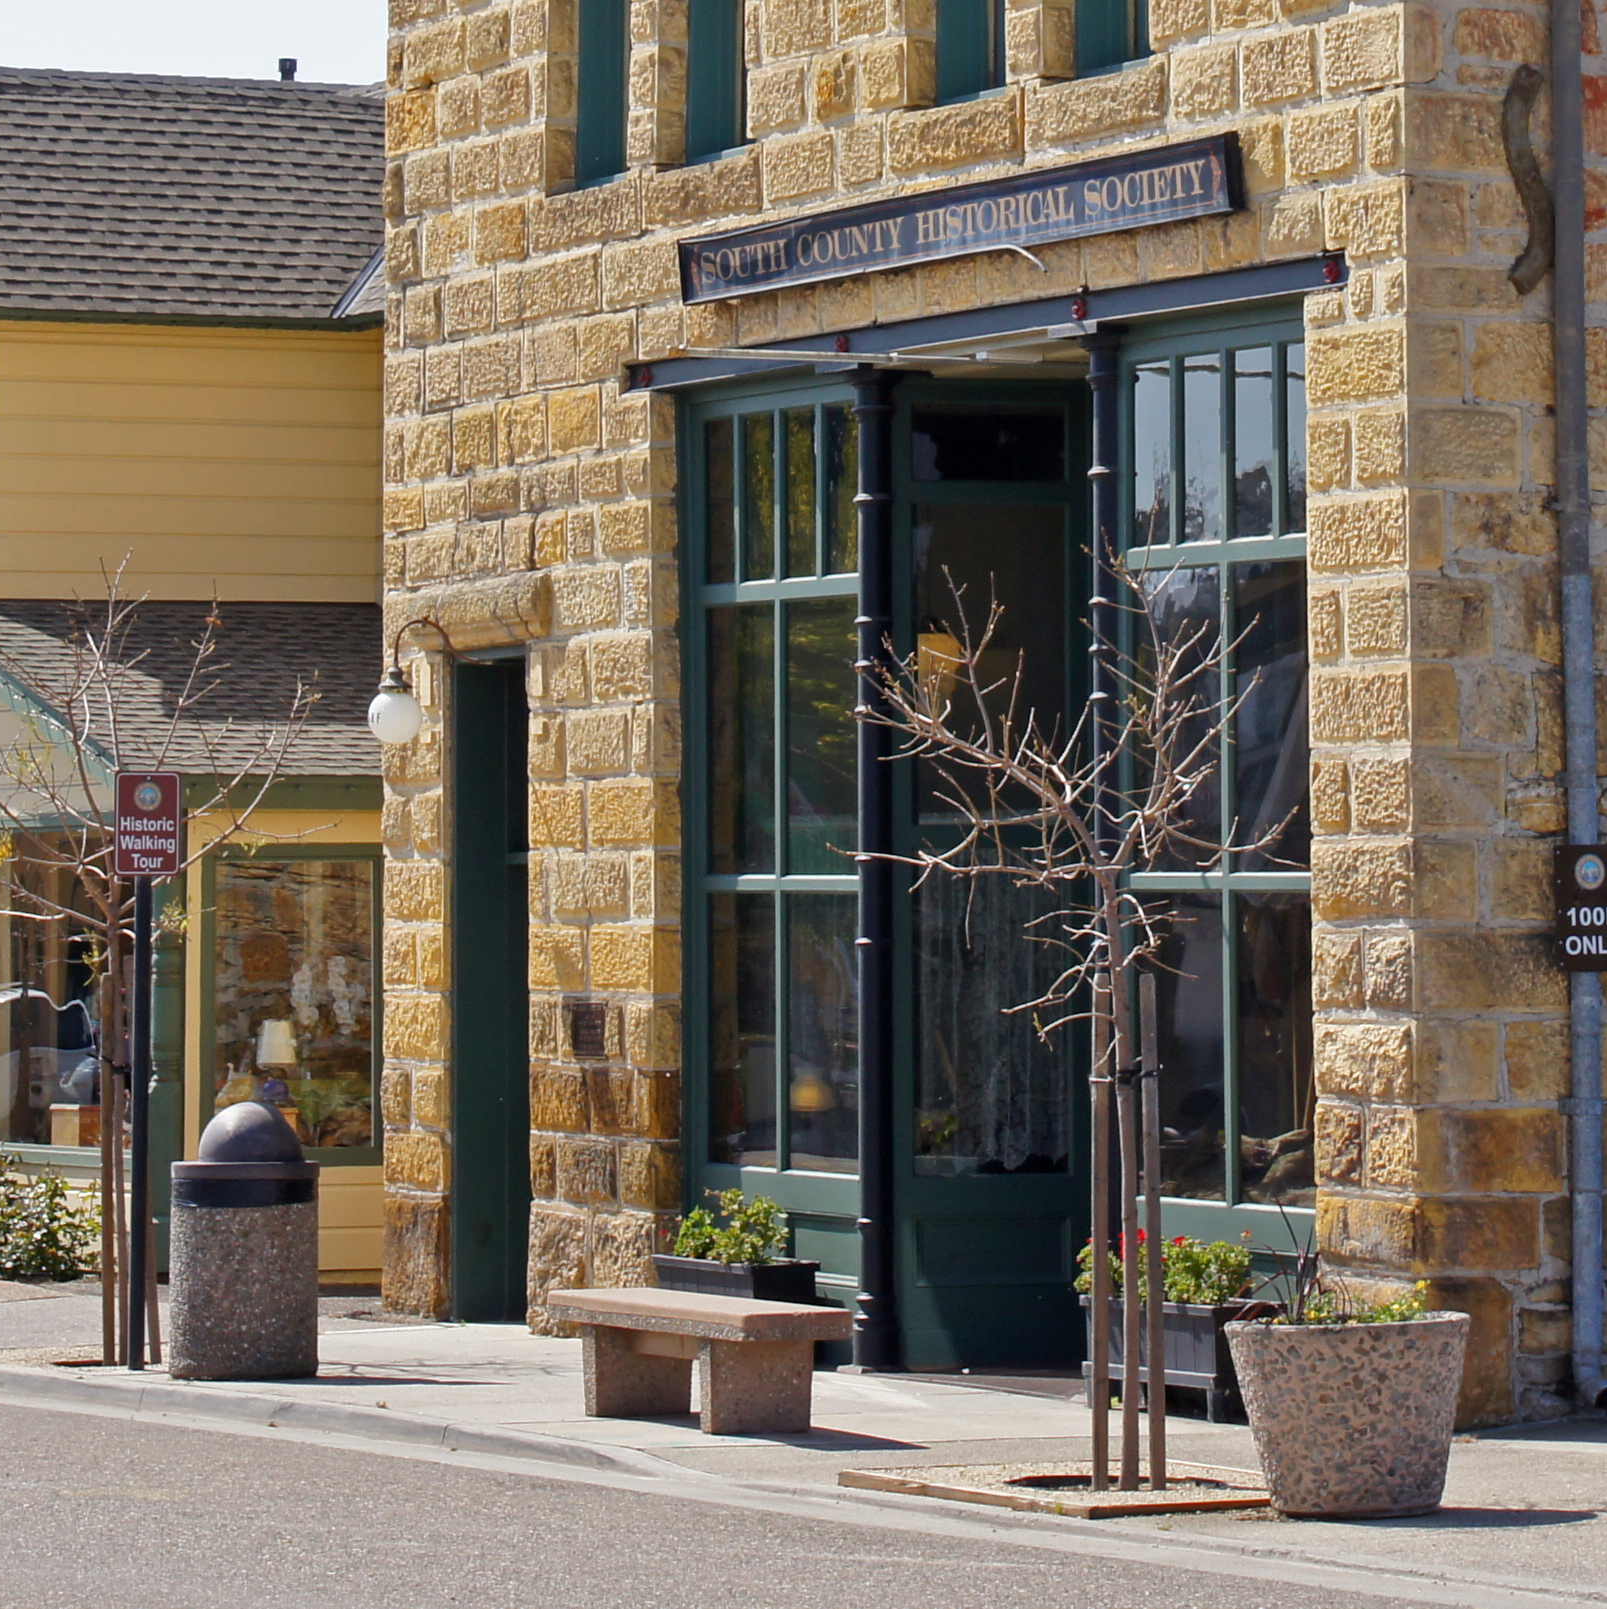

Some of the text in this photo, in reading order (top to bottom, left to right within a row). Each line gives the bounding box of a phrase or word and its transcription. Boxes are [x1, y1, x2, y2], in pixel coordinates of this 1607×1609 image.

[699, 159, 1208, 286] SOUTH COUNTY HISTORICAL SOCIETY
[120, 816, 175, 832] Historic
[120, 835, 176, 854] Walking
[131, 853, 164, 869] Tour
